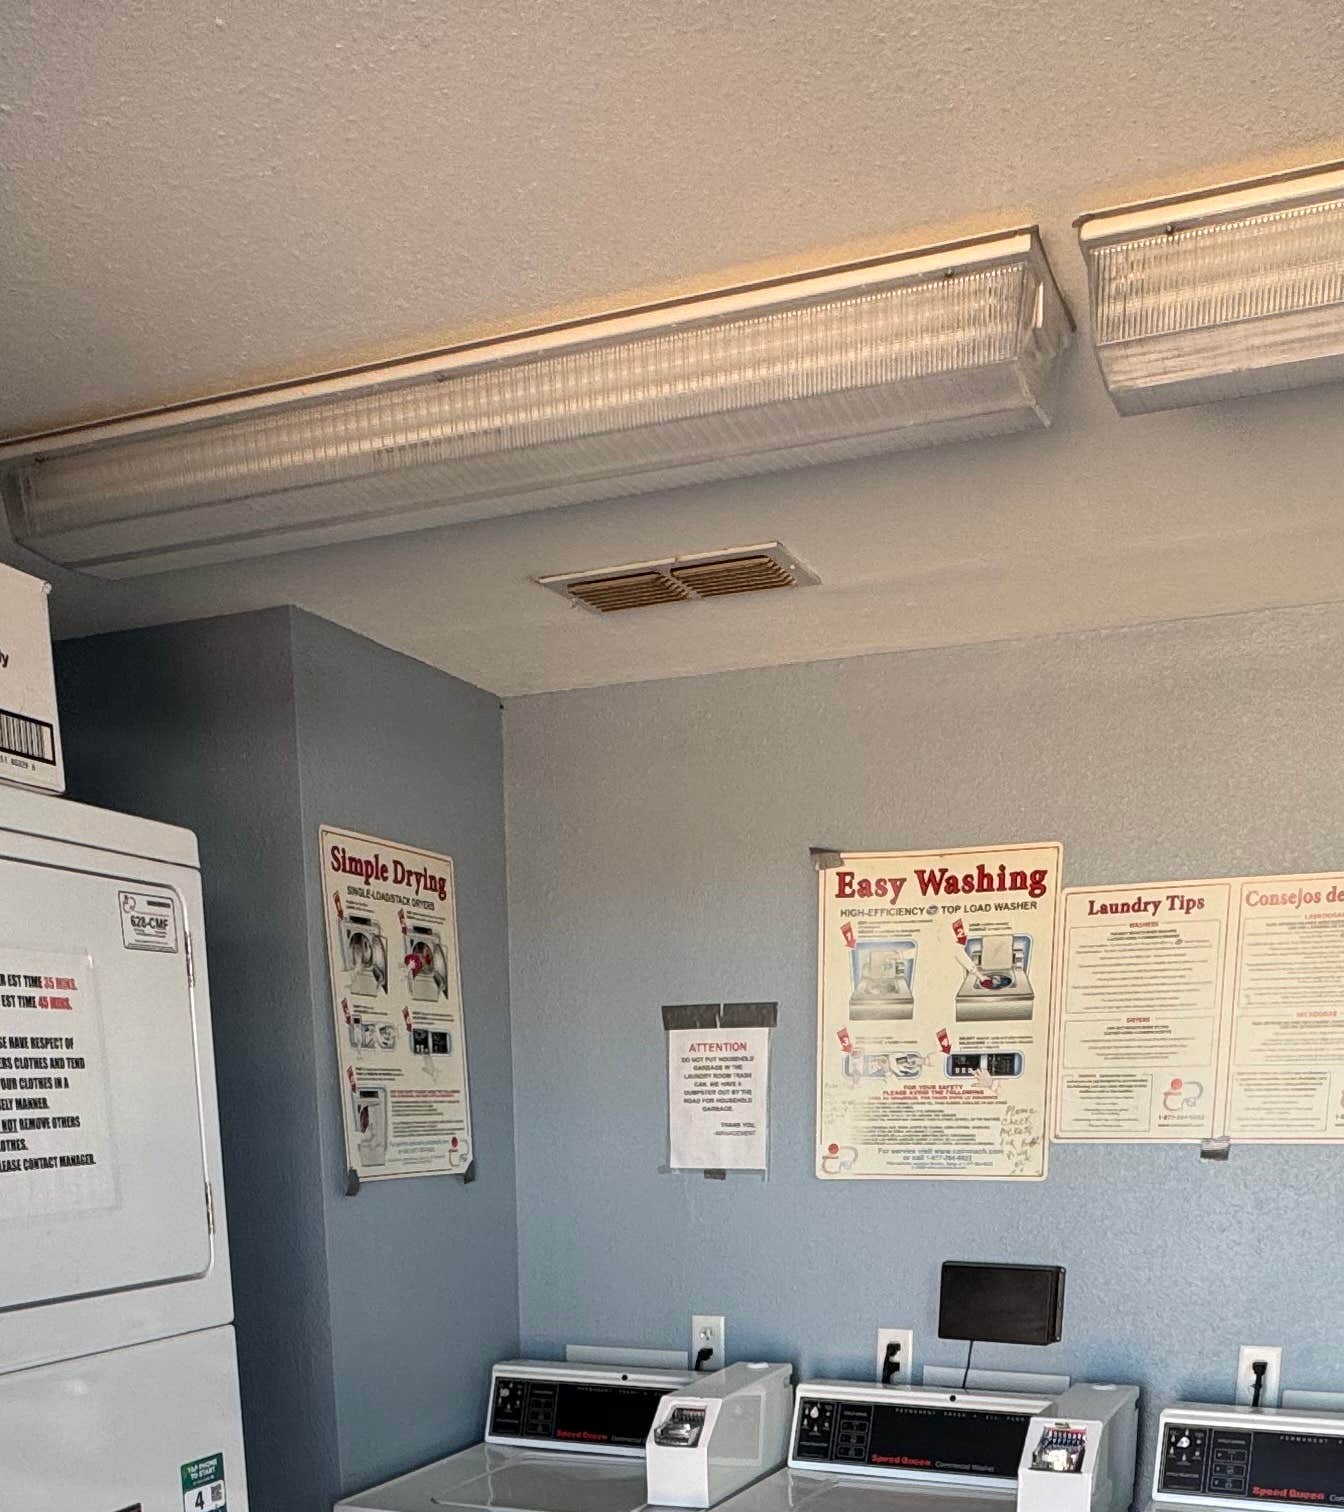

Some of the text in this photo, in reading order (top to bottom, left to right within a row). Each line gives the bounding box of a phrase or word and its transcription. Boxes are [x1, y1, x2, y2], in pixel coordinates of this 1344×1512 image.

[330, 845, 447, 901] Simple Drying
[835, 864, 1049, 905] Easy Washing
[1088, 895, 1205, 916] Laundry Tips
[1245, 888, 1322, 909] Consejos
[840, 901, 1038, 917] HIGH-EFFICIENCY TOP LOAD WASHER
[8, 1036, 29, 1050] HAVE
[30, 1036, 63, 1050] RESPECT
[64, 1037, 74, 1050] OF
[689, 1042, 747, 1052] ATTENTION
[22, 1155, 58, 1171] CONTACT
[59, 1153, 96, 1168] MANAGER.
[195, 1491, 205, 1510] 4
[1252, 1486, 1324, 1501] Speed Queen
